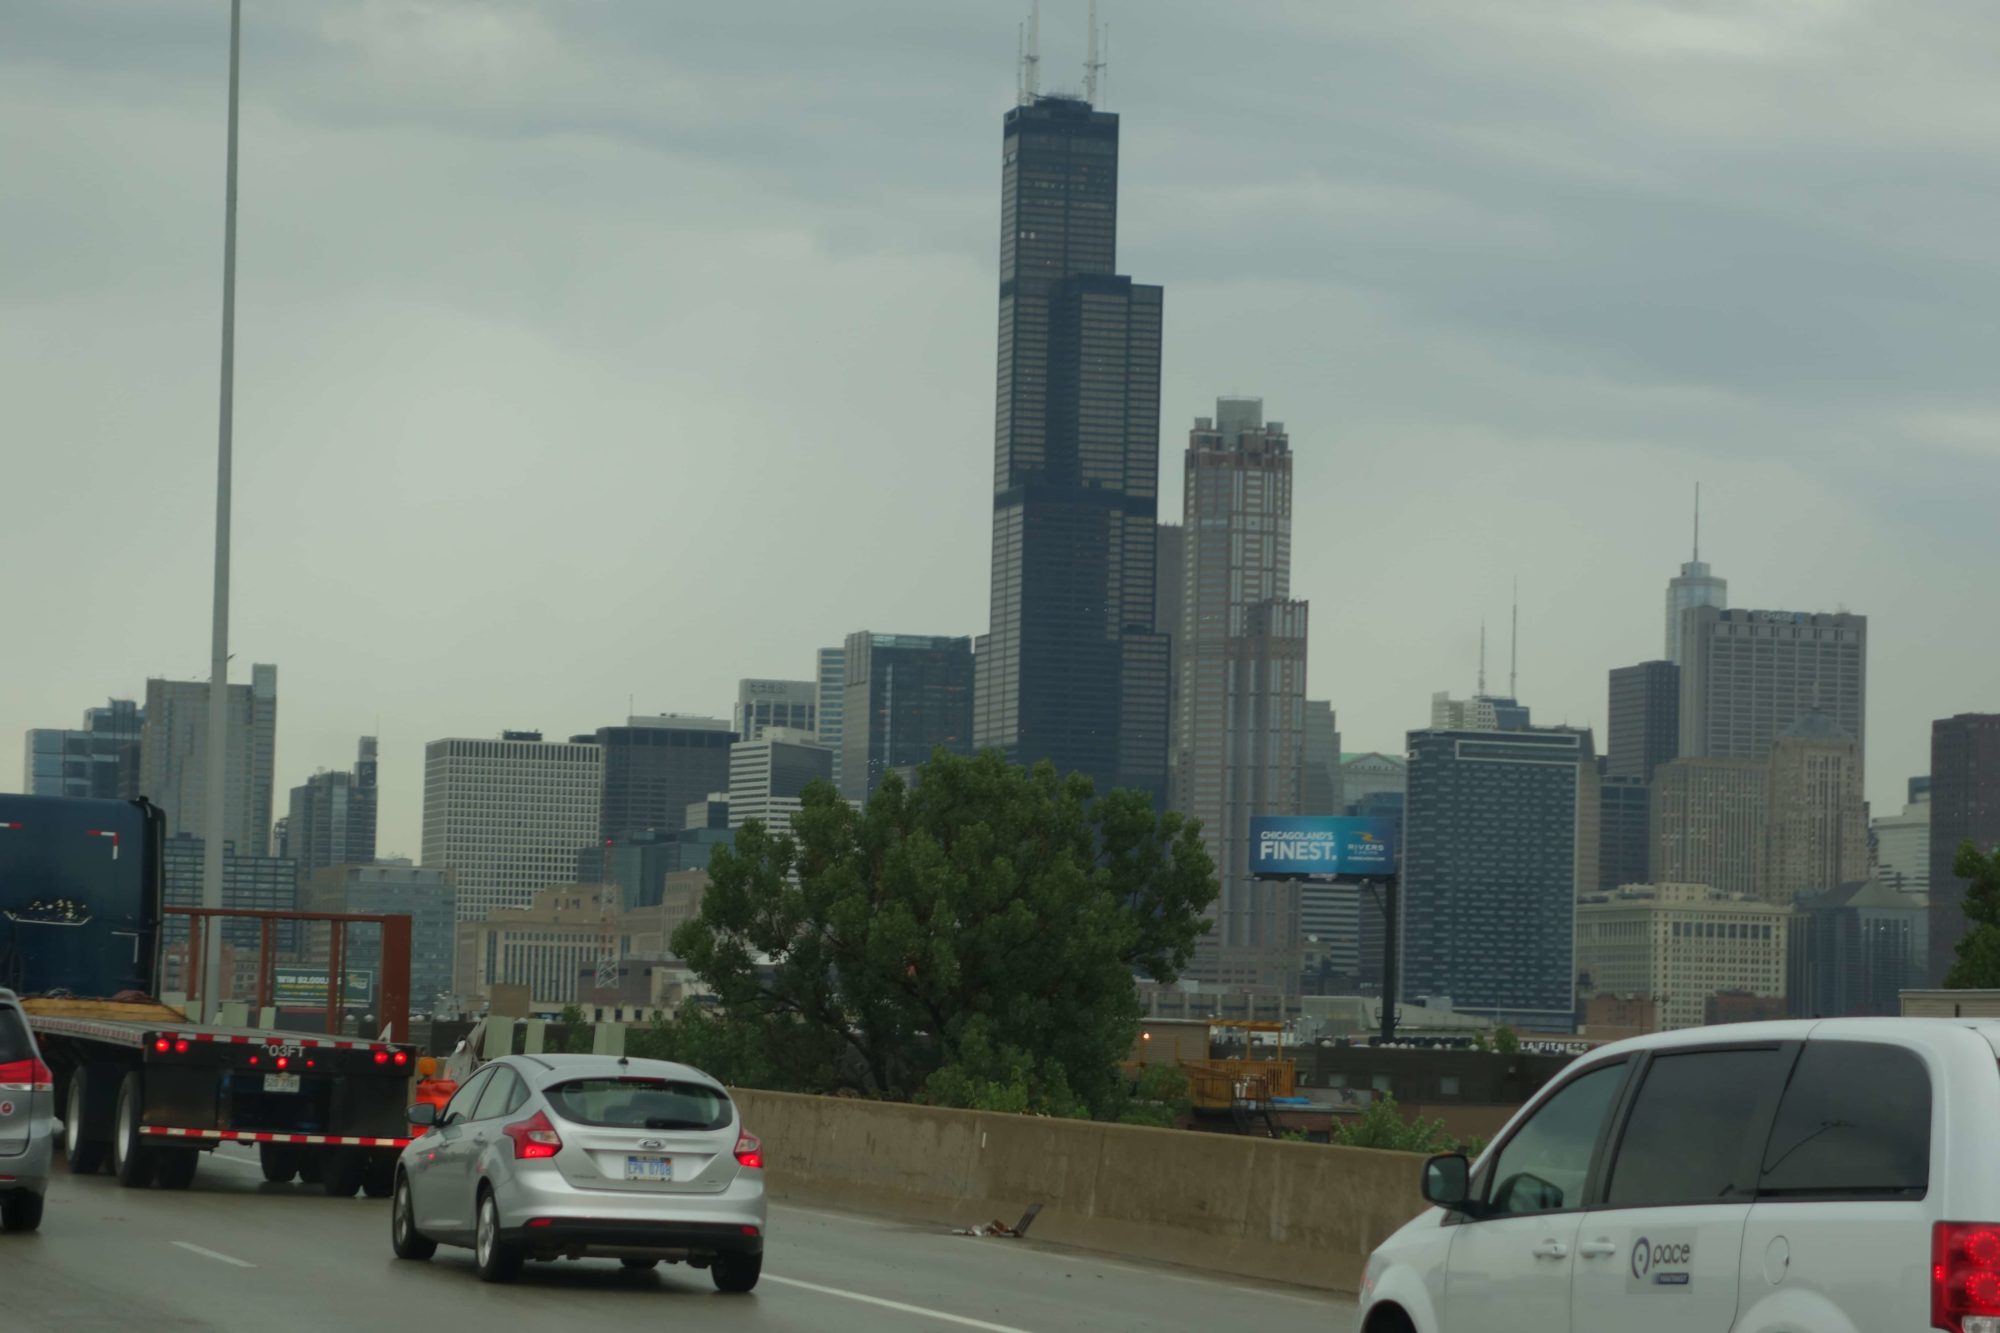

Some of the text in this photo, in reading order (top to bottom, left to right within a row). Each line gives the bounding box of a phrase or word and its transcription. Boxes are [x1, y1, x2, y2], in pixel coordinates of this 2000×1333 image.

[1260, 831, 1334, 840] CHICAGOLAND'S
[1260, 841, 1337, 860] FINEST.
[261, 1045, 306, 1058] 03FT
[1520, 1042, 1587, 1052] LA FITNESS
[1652, 1243, 1690, 1269] pace
